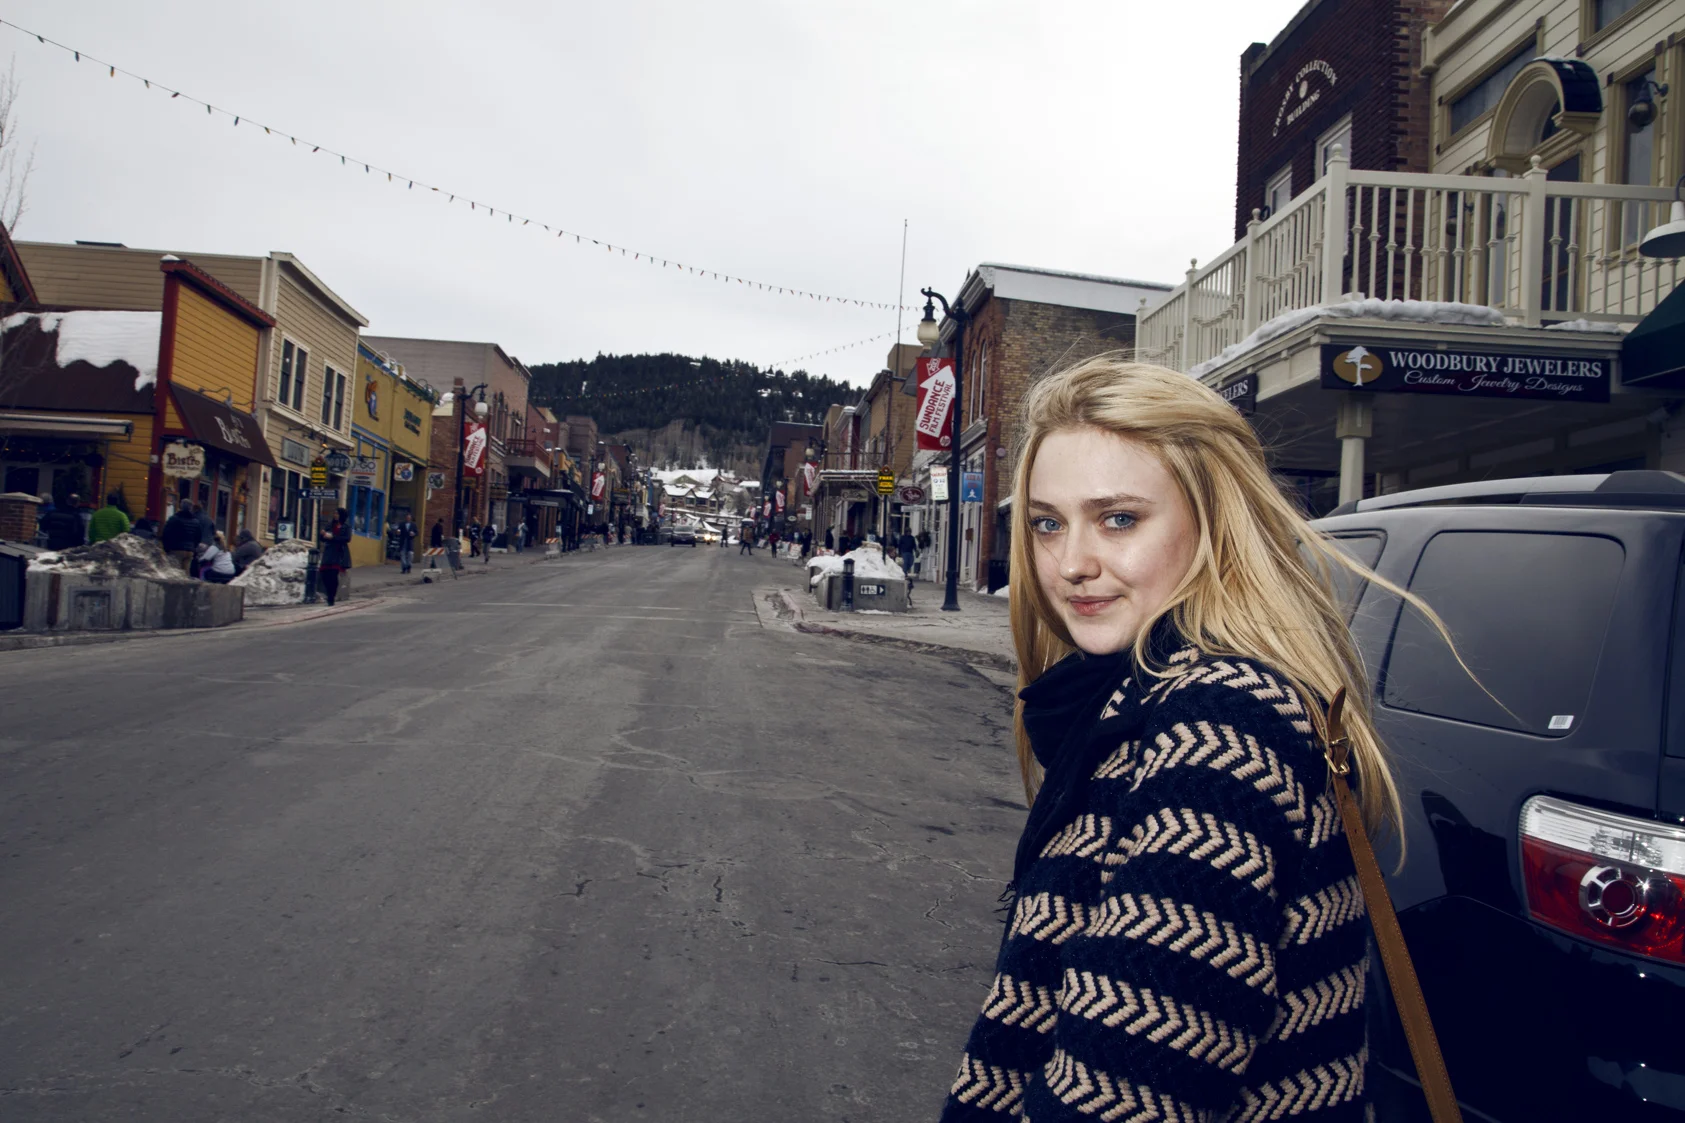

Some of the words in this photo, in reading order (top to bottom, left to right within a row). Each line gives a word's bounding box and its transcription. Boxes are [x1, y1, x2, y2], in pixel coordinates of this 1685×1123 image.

[1295, 60, 1338, 86] COLLECTION
[1287, 89, 1320, 126] BUILDING
[1389, 351, 1501, 372] WOODBURY
[1503, 357, 1602, 378] JEWELERS
[1403, 370, 1456, 385] Custom
[1457, 374, 1521, 393] Jewelry
[1524, 376, 1584, 395] Designs
[919, 379, 945, 430] SUNDANCE
[929, 416, 939, 433] FILM
[934, 383, 953, 417] FESTIVAL
[166, 453, 201, 466] Bistro
